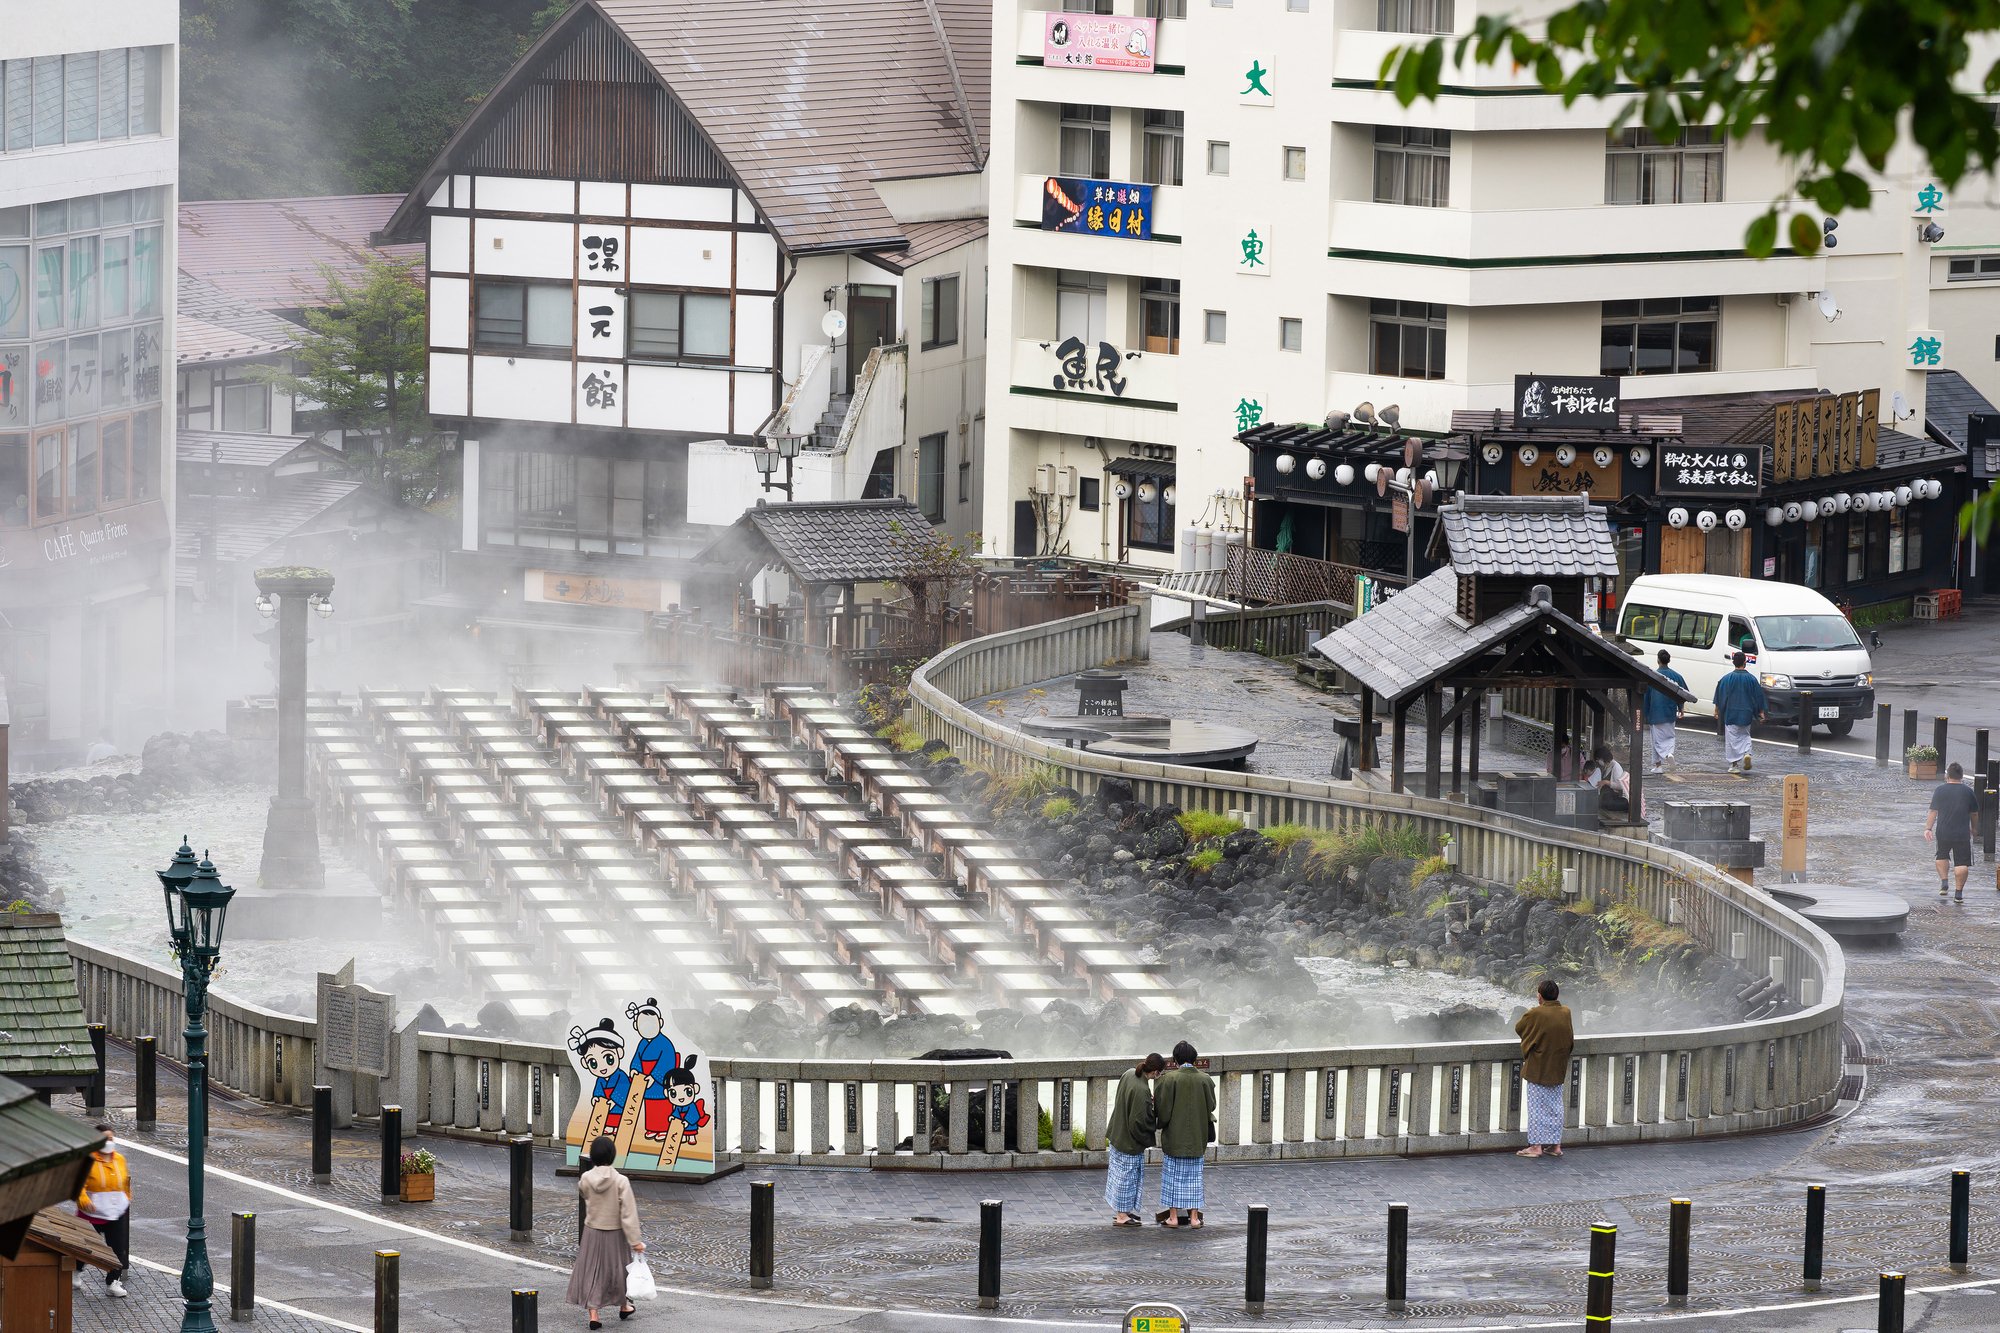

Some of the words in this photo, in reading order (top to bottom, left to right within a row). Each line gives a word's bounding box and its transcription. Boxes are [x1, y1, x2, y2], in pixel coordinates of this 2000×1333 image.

[1073, 21, 1125, 34] ペットと一緒に
[1078, 36, 1119, 50] 入れる温泉
[1087, 205, 1144, 236] 縁日村
[69, 352, 130, 396] ステーキ
[1053, 336, 1127, 396] 魚民
[1551, 385, 1594, 395] 店内打ちたて
[1551, 395, 1617, 415] 十割そば
[1664, 452, 1729, 468] 粋な大人は
[1676, 468, 1757, 486] 蕎麦屋で呑む。
[44, 526, 77, 562] CAFÉ
[79, 528, 105, 552] Quatre
[104, 521, 129, 541] Frères
[623, 1092, 639, 1126] くさつ
[662, 1132, 678, 1165] くさつ
[1139, 1320, 1147, 1331] 2
